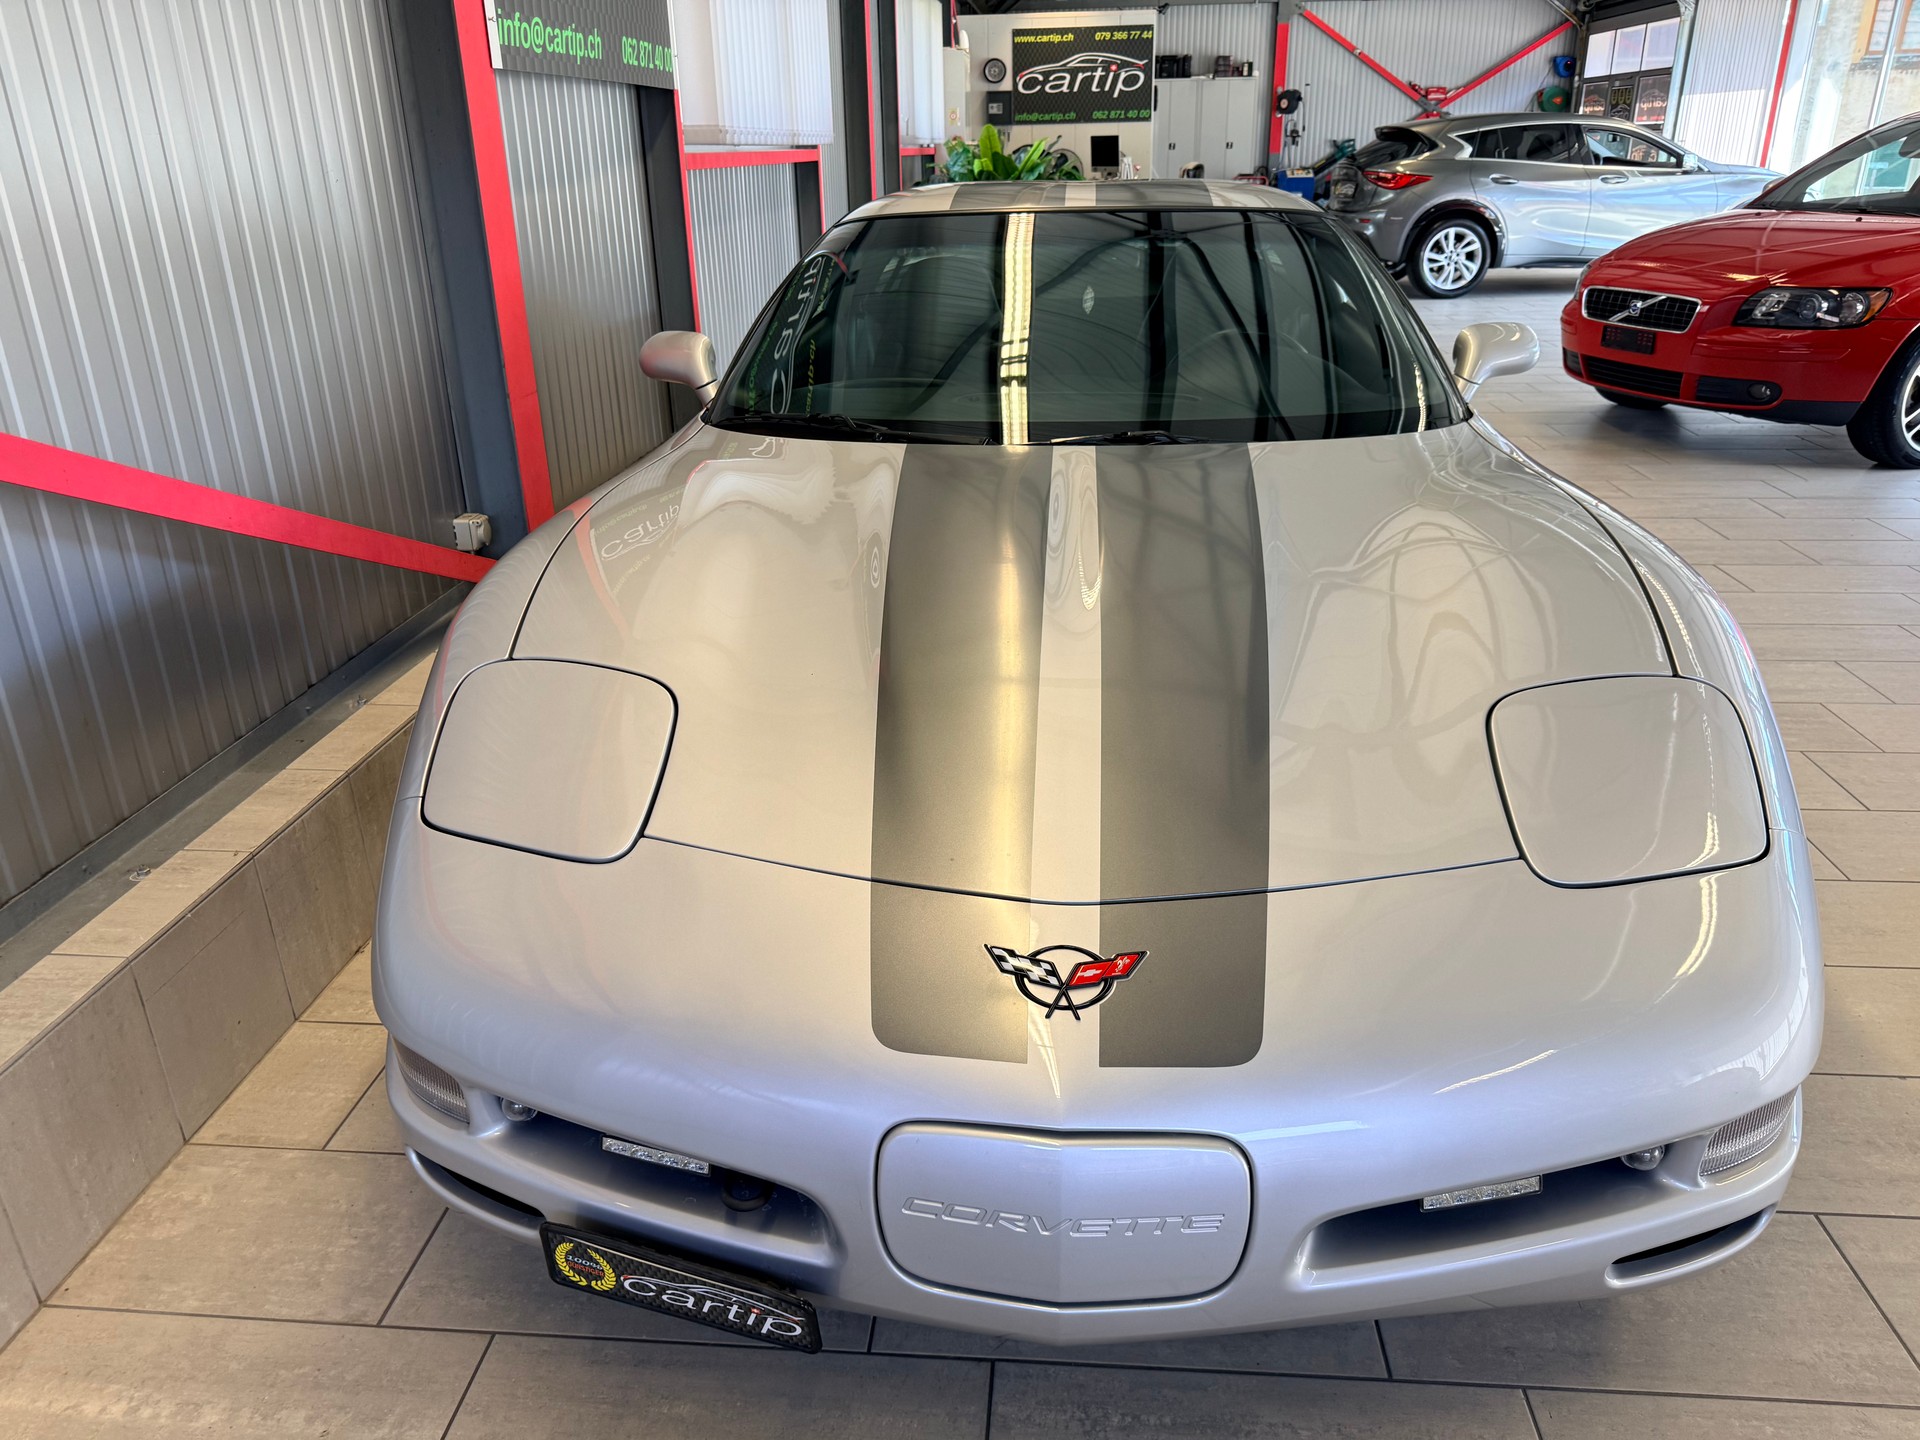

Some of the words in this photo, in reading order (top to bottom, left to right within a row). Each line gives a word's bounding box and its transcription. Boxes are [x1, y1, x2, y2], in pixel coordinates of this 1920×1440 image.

[497, 8, 602, 65] info@cartip.ch
[1014, 33, 1074, 44] www.cartip.ch
[1095, 32, 1111, 41] 079
[1112, 31, 1128, 40] 366
[1129, 31, 1141, 39] 77
[1142, 30, 1153, 39] 44
[622, 36, 638, 66] 062
[640, 40, 654, 68] 871
[655, 44, 664, 71] 40
[1017, 64, 1145, 98] cartip
[1015, 112, 1077, 122] info@cartip.ch
[1092, 110, 1108, 119] 062
[1109, 110, 1125, 119] 871
[1127, 110, 1138, 118] 40
[1139, 109, 1151, 118] 00
[901, 1196, 1225, 1237] CORVETTE
[623, 1277, 802, 1337] cartip
